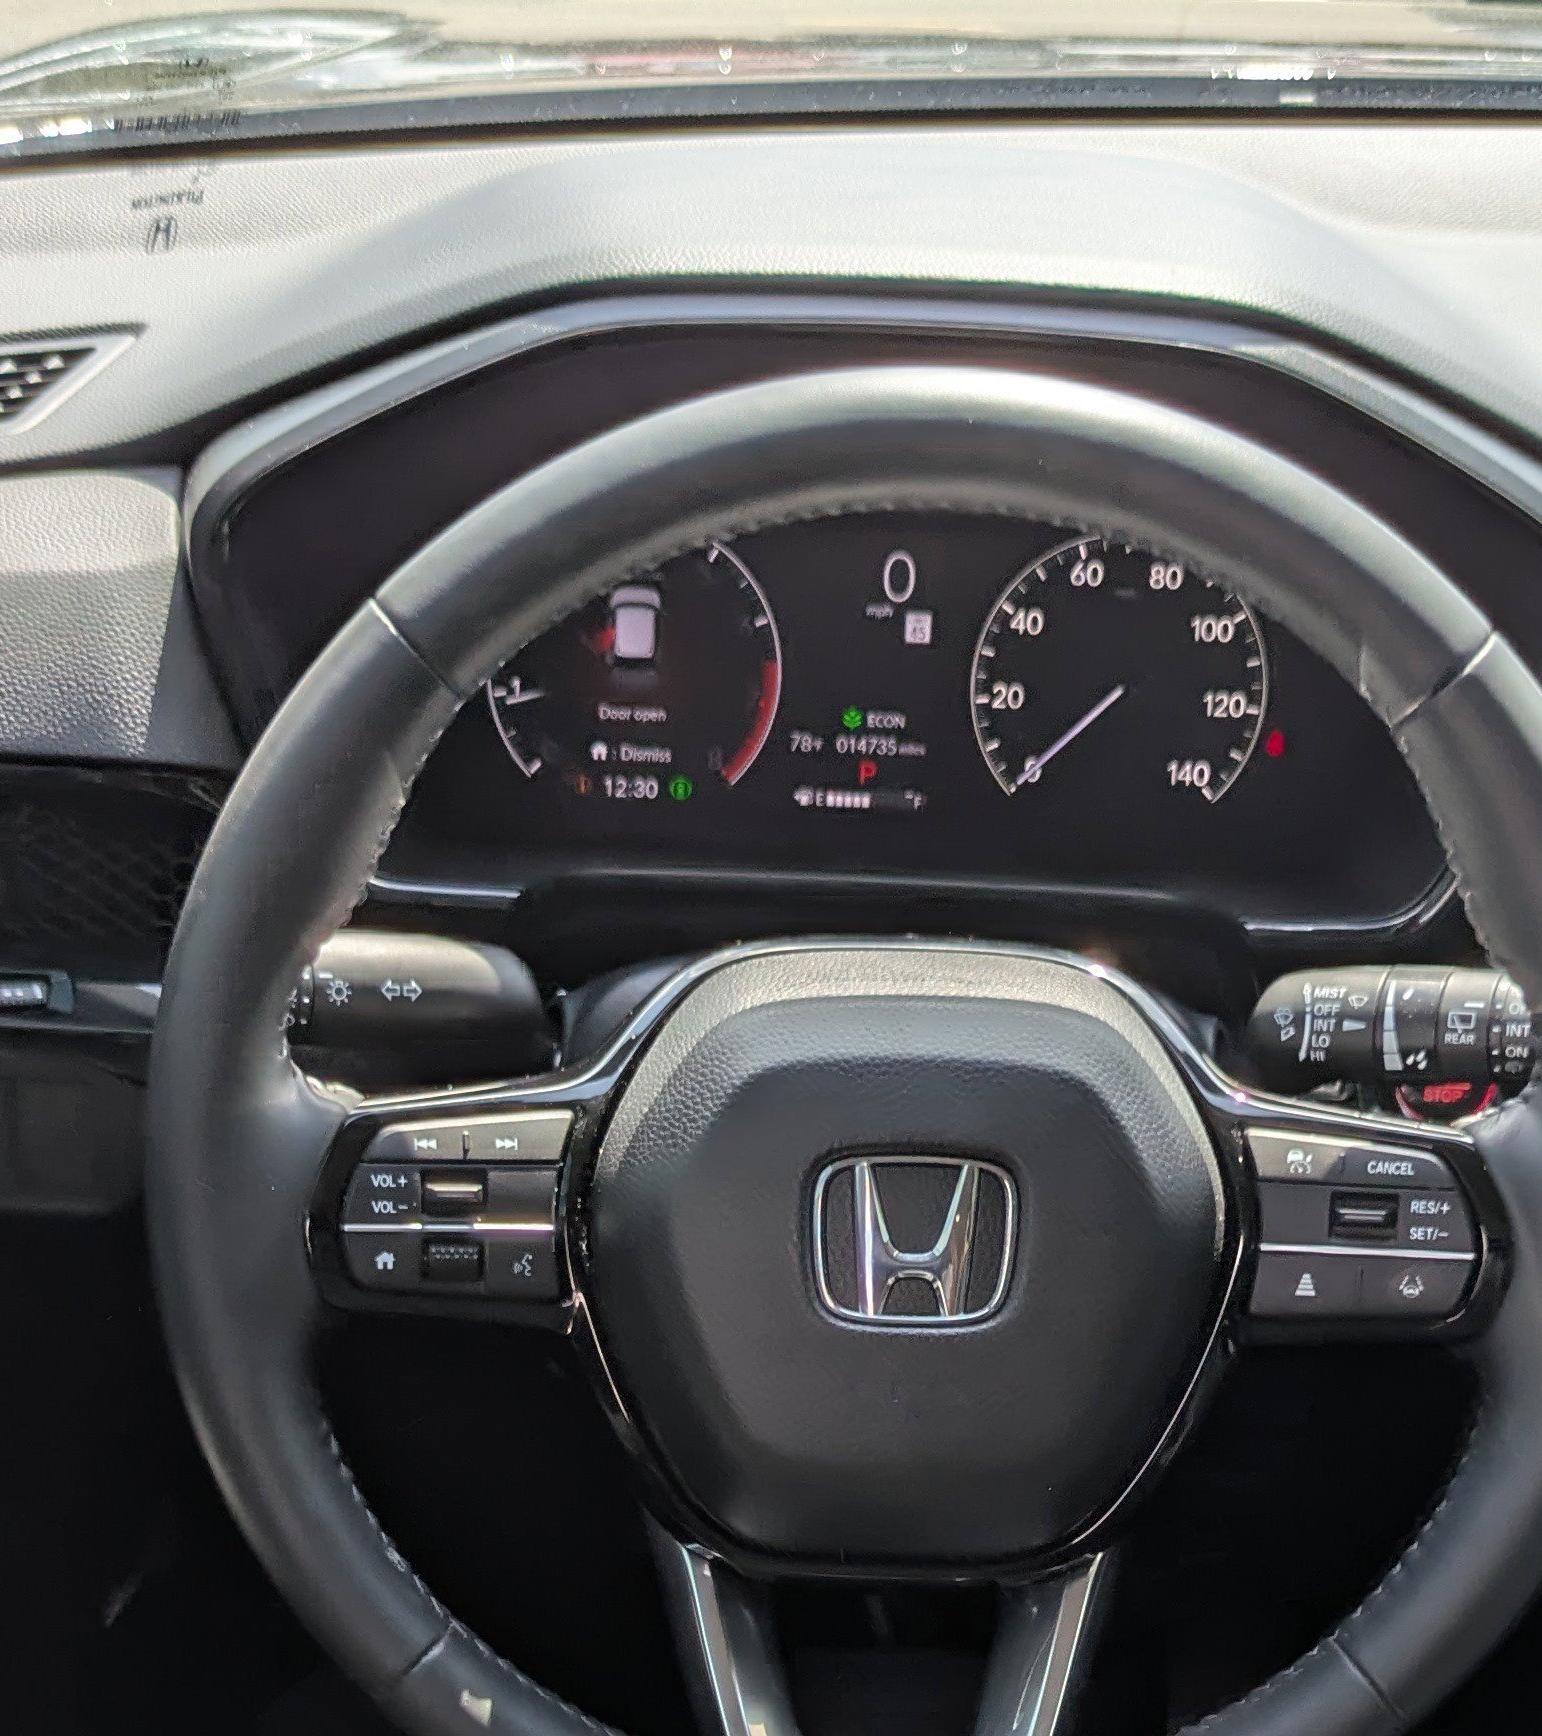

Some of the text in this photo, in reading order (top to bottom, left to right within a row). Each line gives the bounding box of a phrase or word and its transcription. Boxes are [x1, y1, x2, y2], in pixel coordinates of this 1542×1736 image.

[1070, 558, 1105, 588] 60
[1149, 562, 1184, 591] 80
[1010, 608, 1045, 637] 40
[1191, 615, 1235, 643] 100
[992, 682, 1025, 710] 20
[1203, 691, 1247, 718] 120
[598, 703, 667, 723] Door open
[866, 710, 906, 729] ECON
[620, 743, 672, 764] Dismiss
[836, 733, 897, 755] 014735
[859, 757, 879, 784] P
[1167, 760, 1211, 787] 140
[604, 774, 659, 799] 12:30
[1314, 985, 1347, 999] MIST
[1314, 1003, 1340, 1017] OFF
[1314, 1018, 1337, 1033] INT
[1506, 1023, 1531, 1038] INT
[1311, 1033, 1331, 1048] LO
[1445, 1032, 1476, 1046] REAR
[1310, 1049, 1326, 1062] HI
[1505, 1046, 1530, 1059] ON
[1366, 1160, 1416, 1177] CANCEL
[1410, 1200, 1452, 1216] RES/+
